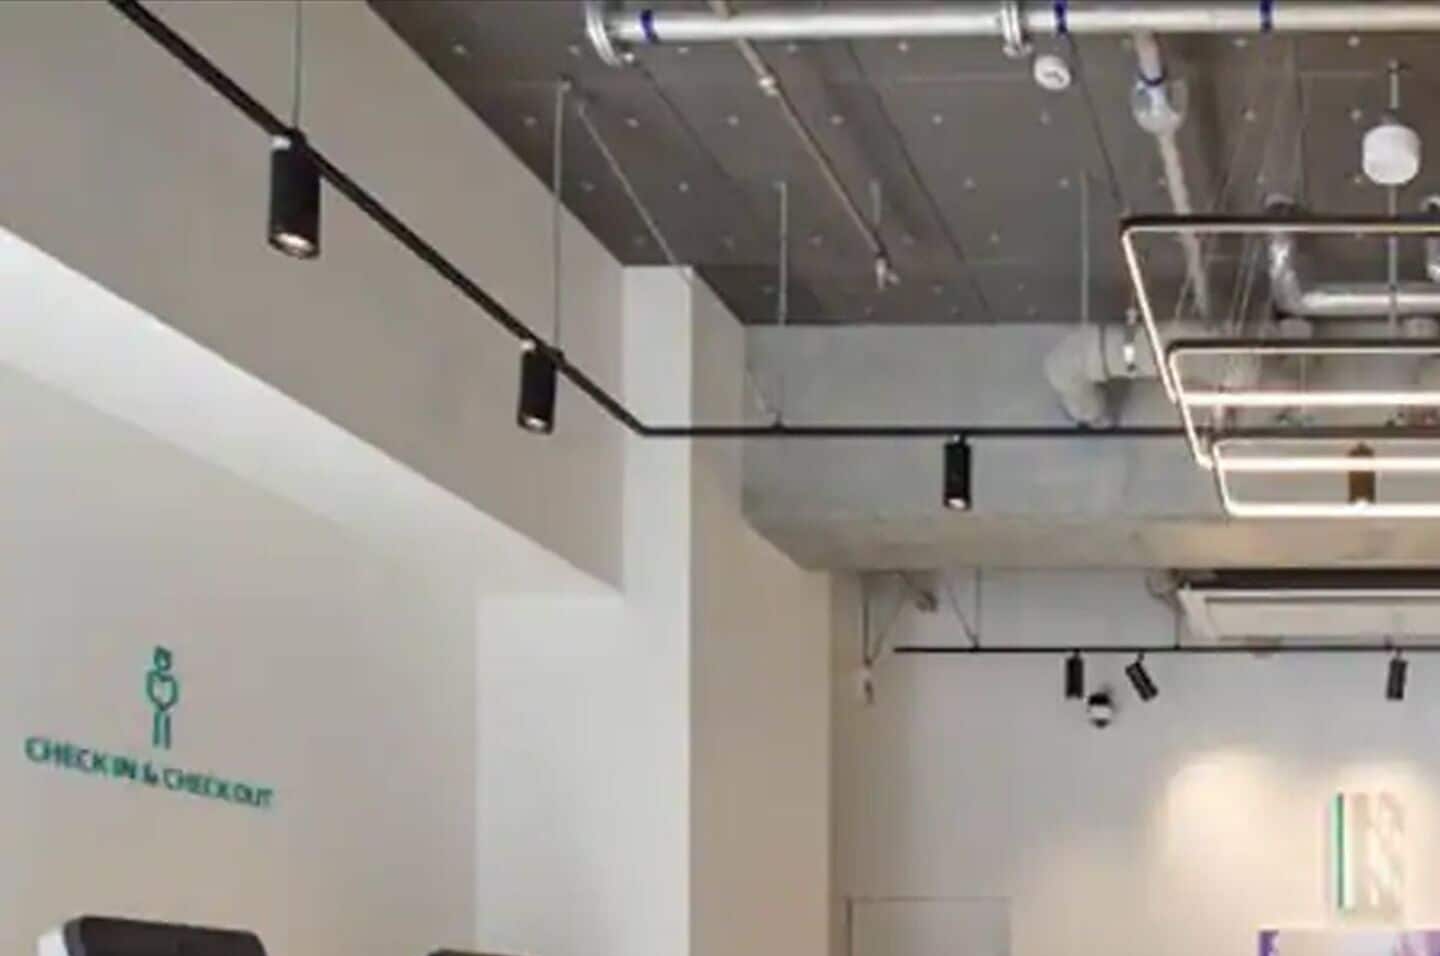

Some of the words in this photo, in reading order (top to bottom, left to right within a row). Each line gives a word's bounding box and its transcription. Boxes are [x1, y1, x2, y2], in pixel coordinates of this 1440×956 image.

[25, 736, 108, 773] CHECK
[112, 755, 136, 780] IN
[143, 762, 159, 786] &
[163, 767, 229, 800] CHECK
[232, 784, 273, 808] OUT
